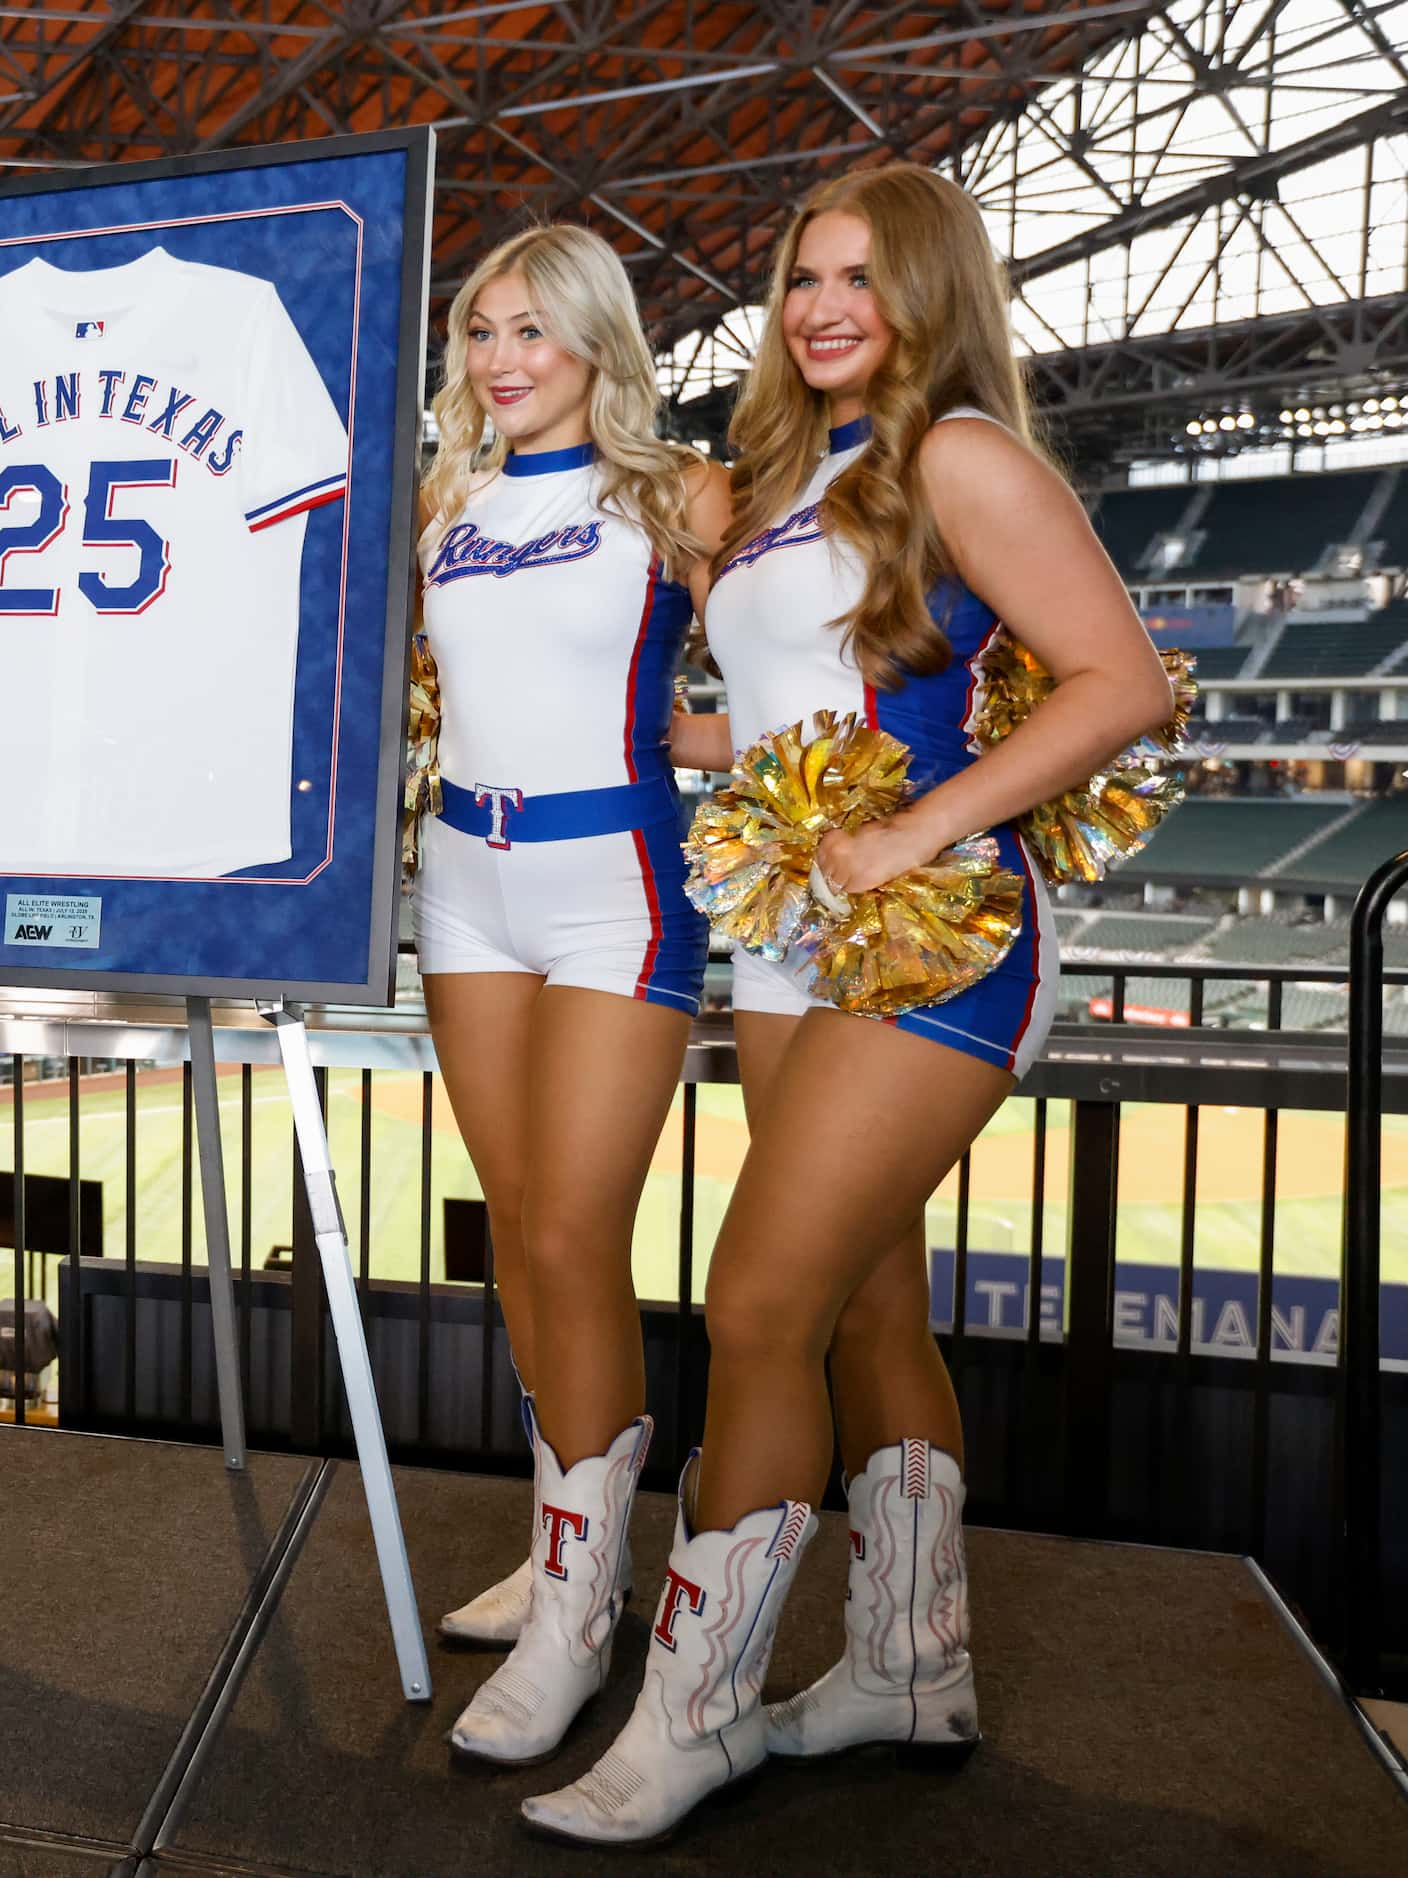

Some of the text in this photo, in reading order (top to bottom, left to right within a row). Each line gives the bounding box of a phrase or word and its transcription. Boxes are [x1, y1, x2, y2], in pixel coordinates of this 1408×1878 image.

[32, 371, 82, 429] IN
[98, 369, 244, 476] TEXAS
[422, 520, 606, 588] Rangers
[474, 783, 524, 851] T
[14, 924, 54, 941] AEW
[31, 900, 49, 908] ELITE
[51, 901, 89, 909] WRESTLING
[974, 1279, 1340, 1354] TEEMANA
[542, 1502, 588, 1582] T
[652, 1568, 707, 1654] T
